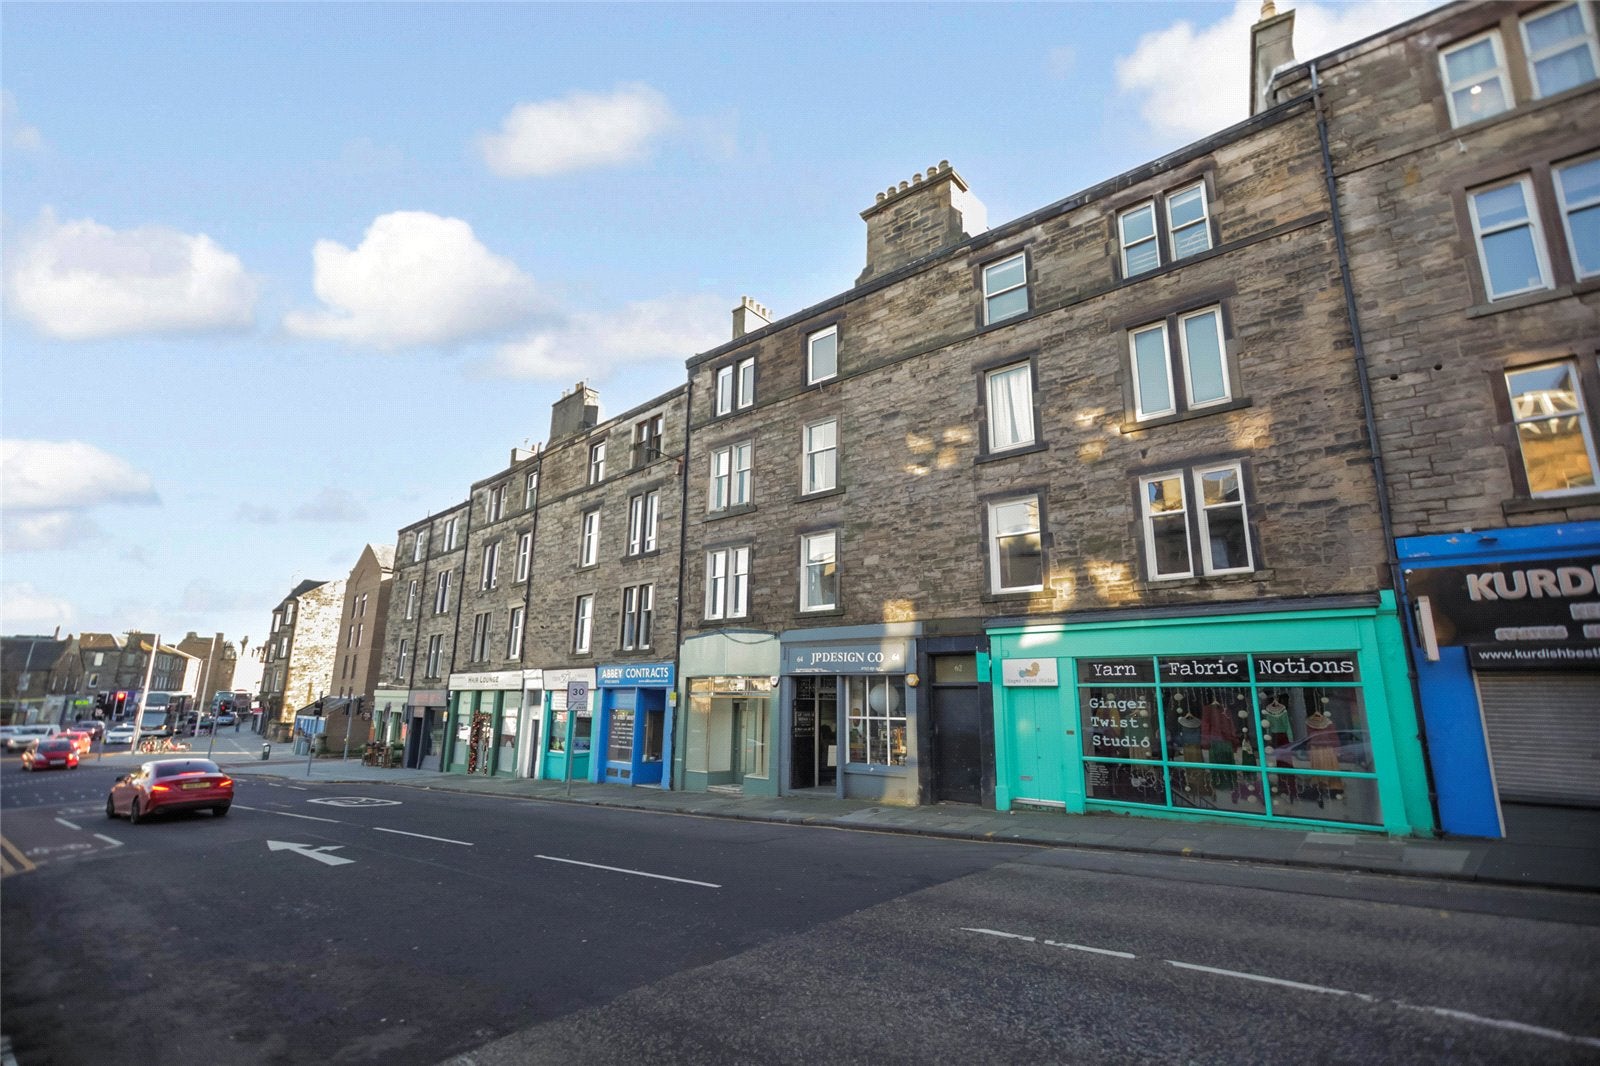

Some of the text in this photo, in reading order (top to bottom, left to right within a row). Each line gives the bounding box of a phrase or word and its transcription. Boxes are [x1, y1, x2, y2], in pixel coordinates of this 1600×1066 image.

[796, 655, 804, 663] 64
[810, 651, 884, 666] JPDESIGN CO
[891, 653, 900, 662] 64
[1093, 663, 1137, 677] Yarn
[1168, 659, 1239, 676] Fabric
[1258, 657, 1355, 675] Notions
[601, 668, 623, 679] ABBEY
[625, 667, 669, 679] CONTRACTS
[479, 676, 499, 684] LOUNGE
[572, 688, 585, 696] 30
[1089, 697, 1147, 711] Ginger
[1090, 716, 1139, 729] Twist
[1092, 735, 1151, 748] Studio
